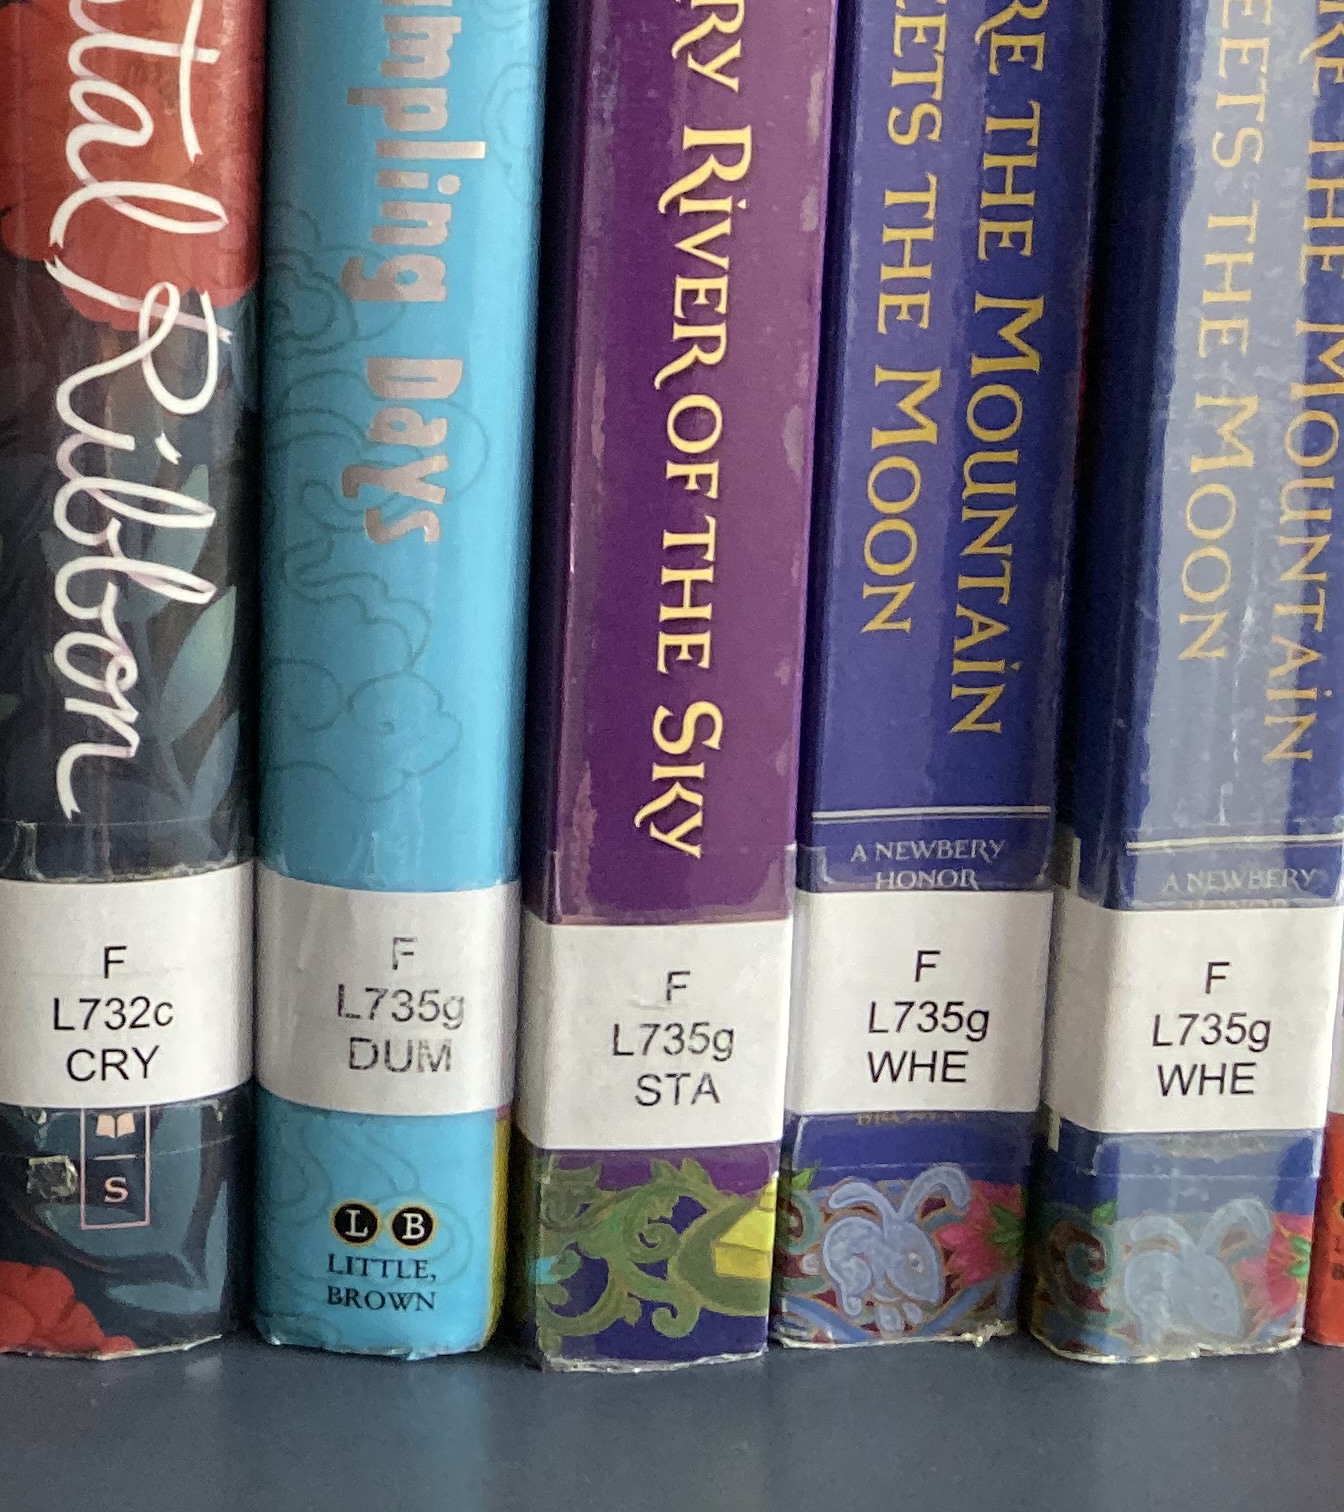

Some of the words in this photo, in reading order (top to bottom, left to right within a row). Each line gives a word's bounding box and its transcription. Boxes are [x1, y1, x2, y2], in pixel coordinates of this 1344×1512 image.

[341, 357, 464, 544] Days
[861, 364, 942, 634] MOON
[44, 257, 233, 819] Ribbon
[1178, 392, 1258, 662] MOON
[657, 516, 719, 674] THE
[633, 700, 724, 860] SKY
[851, 843, 867, 863] A
[875, 839, 1005, 863] NEWBERY
[875, 869, 979, 890] HONOR
[1186, 867, 1320, 891] NEWBERY
[103, 945, 127, 979] F
[915, 950, 941, 983] F
[53, 996, 174, 1031] L732c
[336, 983, 466, 1030] L735g
[868, 1001, 990, 1042] L735g
[612, 1022, 735, 1062] L735g
[1152, 1013, 1271, 1052] L735g
[66, 1045, 160, 1081] CRY
[348, 1037, 454, 1072] DUM
[867, 1050, 968, 1084] WHE
[634, 1073, 721, 1108] STA
[1157, 1062, 1257, 1096] WHE
[344, 1209, 368, 1238] L
[402, 1212, 425, 1240] B
[327, 1253, 437, 1281] LITTLE,
[327, 1285, 436, 1311] BROWN
